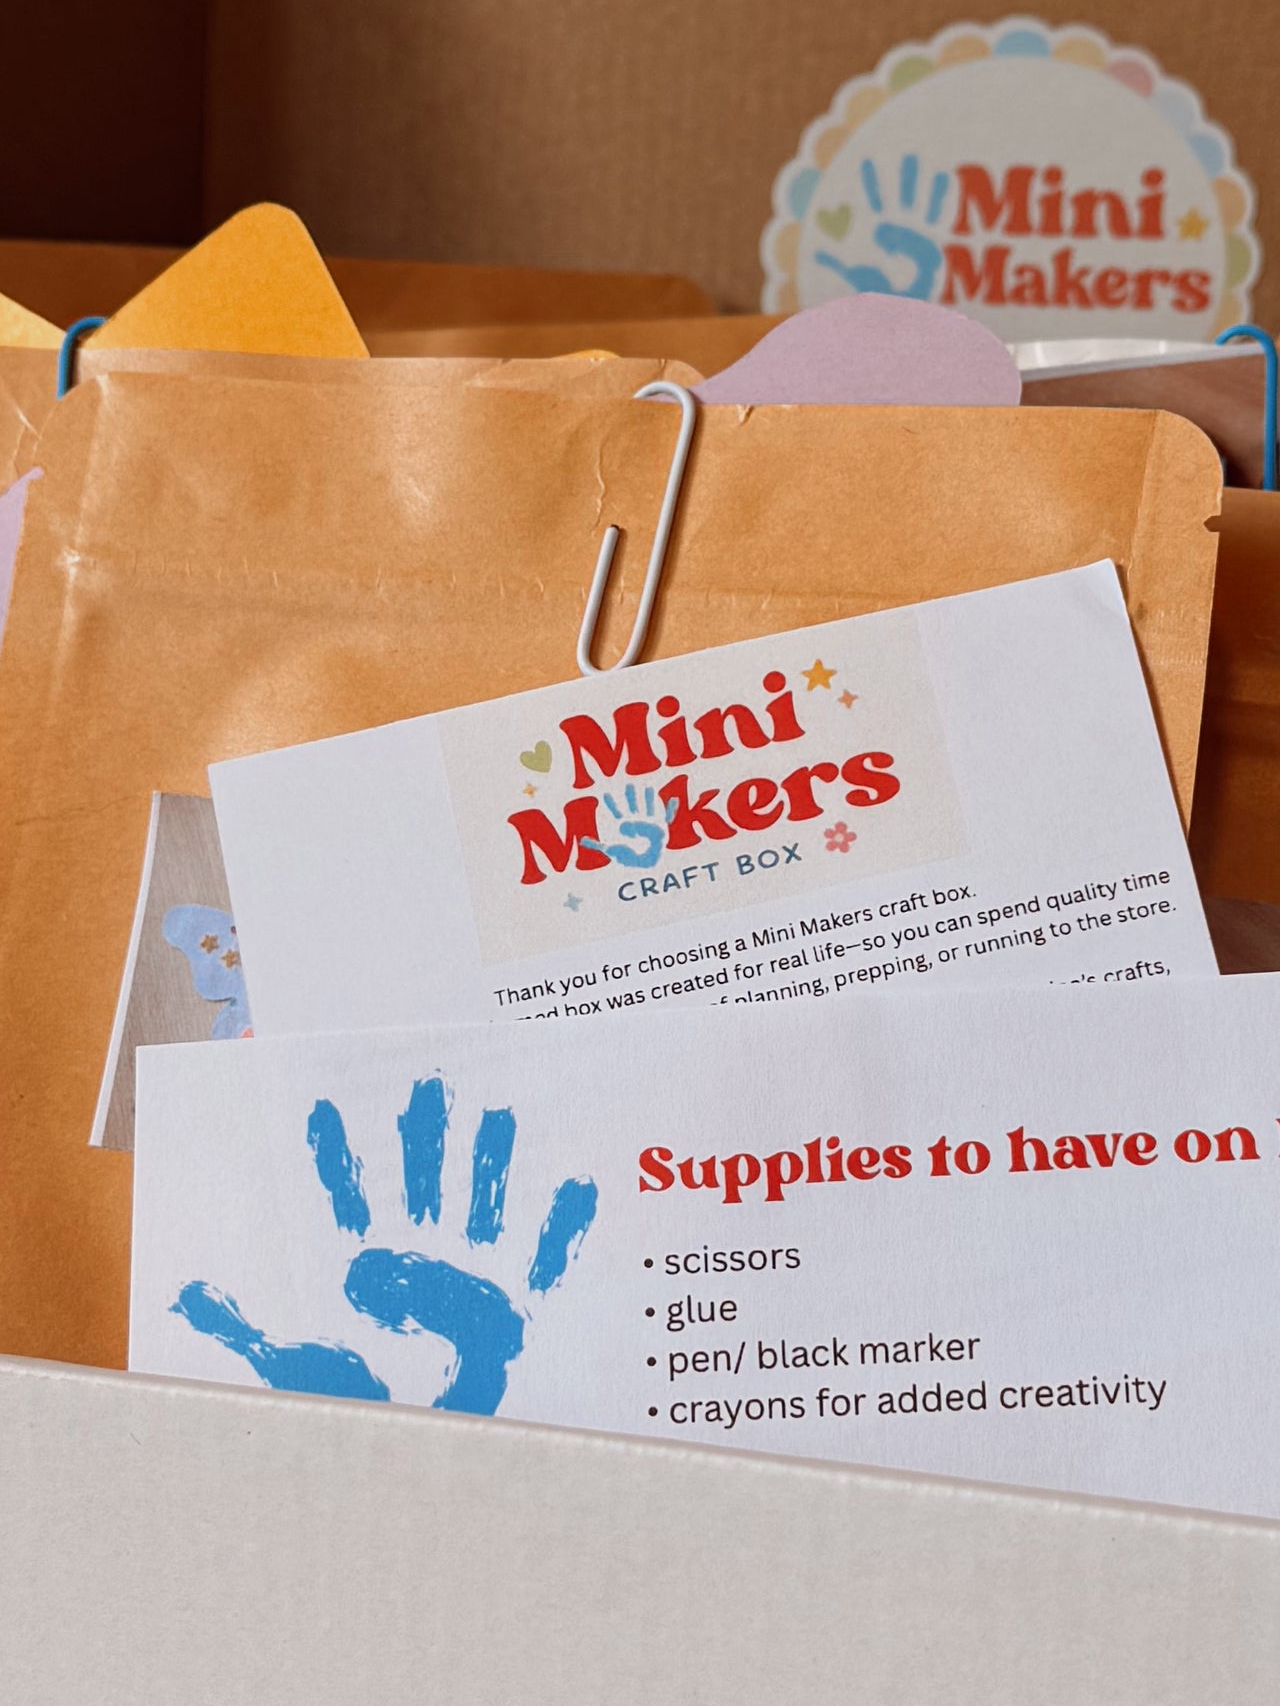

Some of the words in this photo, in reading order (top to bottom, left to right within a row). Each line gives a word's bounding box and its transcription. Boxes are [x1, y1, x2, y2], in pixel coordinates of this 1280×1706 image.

[951, 164, 1166, 240] Mini
[939, 245, 1212, 313] Makers
[559, 670, 806, 789] Mini
[507, 751, 901, 885] Mkers
[618, 861, 720, 902] CRAFT
[736, 842, 803, 876] BOX
[494, 979, 556, 1007] Thank
[560, 971, 597, 996] you
[602, 962, 631, 981] for
[638, 941, 730, 974] choosing
[734, 937, 748, 952] a
[752, 922, 796, 948] Mini
[800, 909, 873, 936] Makers
[878, 893, 927, 919] craft
[933, 884, 977, 906] box.
[606, 991, 645, 1010] was
[651, 969, 729, 1000] created
[733, 961, 763, 981] for
[770, 949, 809, 973] real
[892, 925, 930, 949] you
[935, 915, 972, 934] can
[977, 896, 1041, 926] spend
[1047, 881, 1118, 911] quality
[1122, 870, 1171, 892] time
[834, 954, 933, 991] prepping,
[937, 945, 959, 963] or
[966, 927, 1046, 958] running
[1049, 920, 1072, 938] to
[1077, 909, 1112, 932] the
[1117, 897, 1177, 923] store.
[637, 1135, 912, 1204] Supplies
[927, 1134, 991, 1178] to
[1006, 1126, 1158, 1173] have
[1173, 1122, 1261, 1164] on
[663, 1243, 801, 1276] scissors
[665, 1294, 738, 1333] glue
[668, 1342, 746, 1376] pen/
[757, 1337, 849, 1370] black
[858, 1332, 981, 1365] marker
[668, 1393, 807, 1427] crayons
[816, 1387, 866, 1419] for
[876, 1382, 988, 1415] added
[998, 1375, 1167, 1411] creativity
